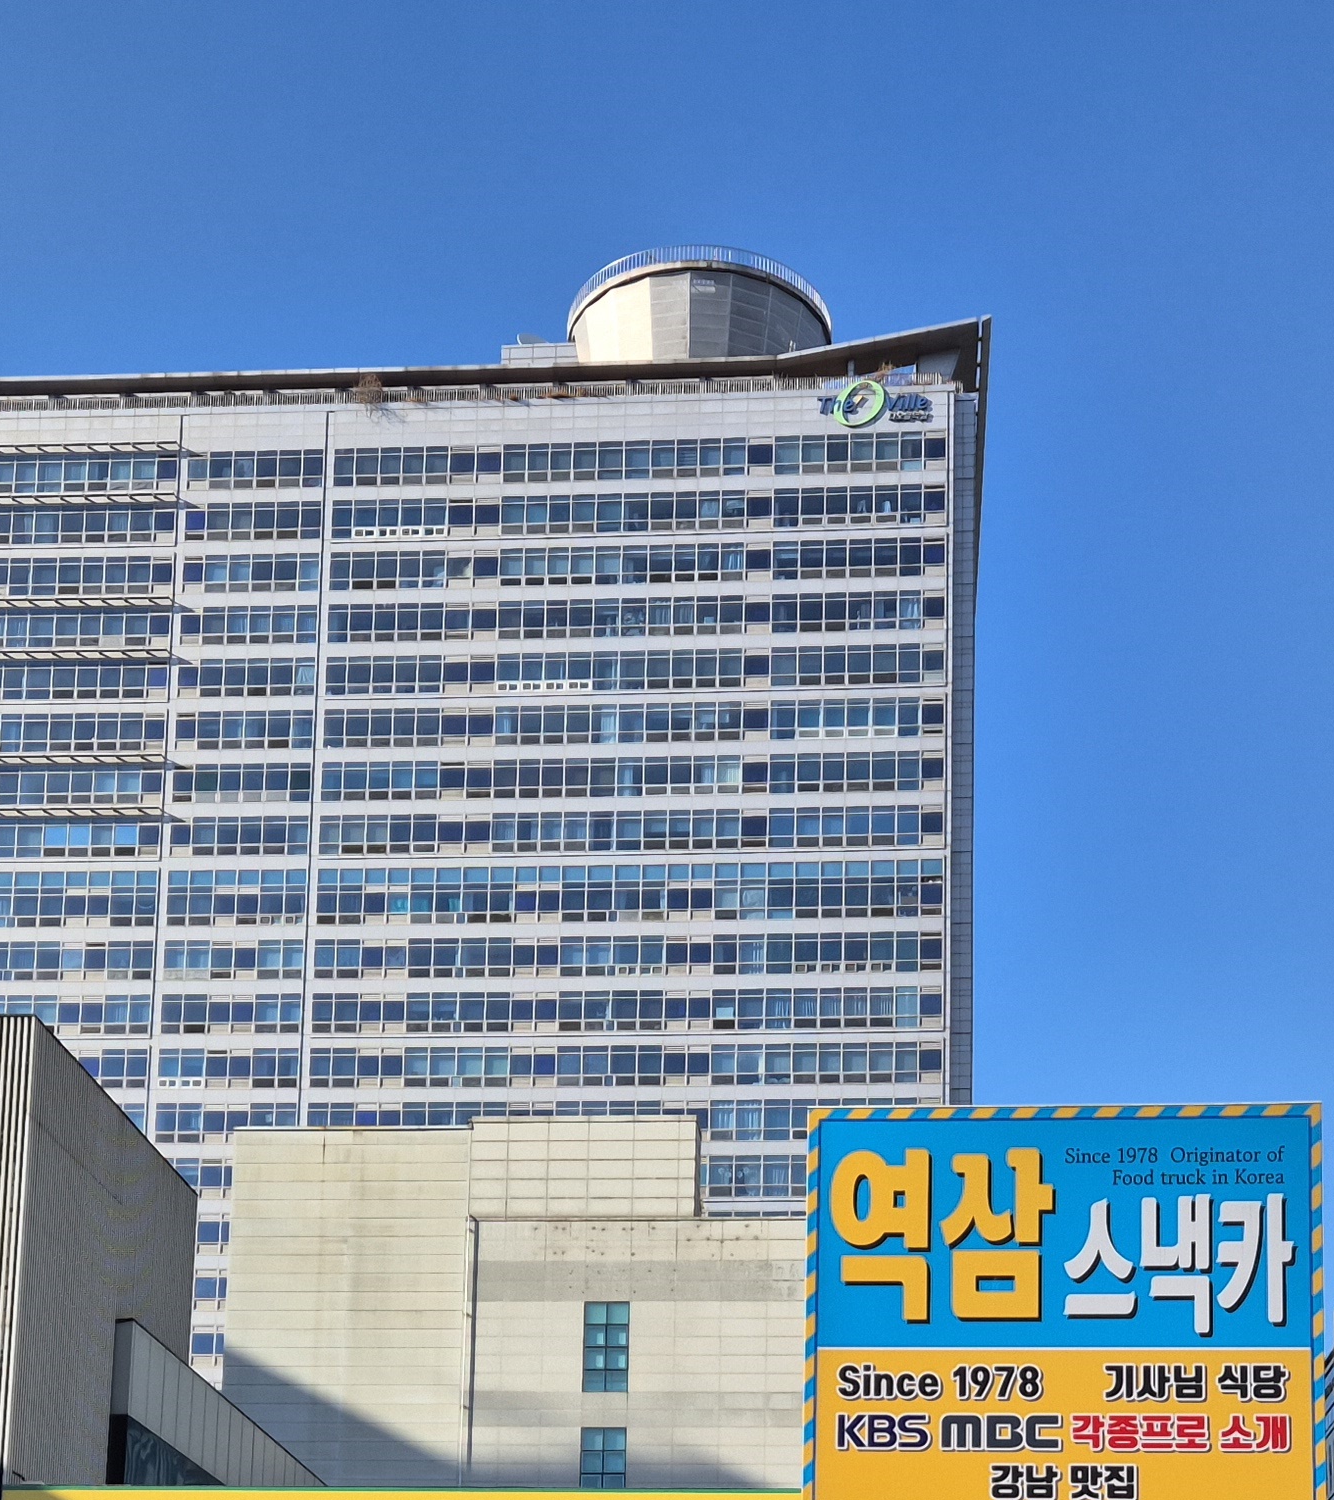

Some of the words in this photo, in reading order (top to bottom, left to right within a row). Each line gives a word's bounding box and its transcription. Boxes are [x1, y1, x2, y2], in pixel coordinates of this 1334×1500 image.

[1065, 1147, 1111, 1164] Since
[1117, 1147, 1158, 1164] 1978
[1170, 1146, 1261, 1165] Originator
[1266, 1145, 1285, 1164] of
[1112, 1169, 1154, 1186] Food
[1160, 1168, 1206, 1186] truck
[1211, 1168, 1229, 1185] in
[1234, 1167, 1285, 1185] Korea
[829, 1147, 1056, 1322] 역삼
[1063, 1193, 1296, 1336] 스낵카
[838, 1364, 942, 1401] Since
[952, 1364, 1044, 1401] 1978
[1103, 1364, 1204, 1402] 기사님
[1217, 1364, 1289, 1402] 식당
[836, 1414, 930, 1450] KBS
[941, 1414, 1063, 1451] MBC
[1070, 1414, 1211, 1452] 각종프로
[1220, 1414, 1290, 1452] 소개
